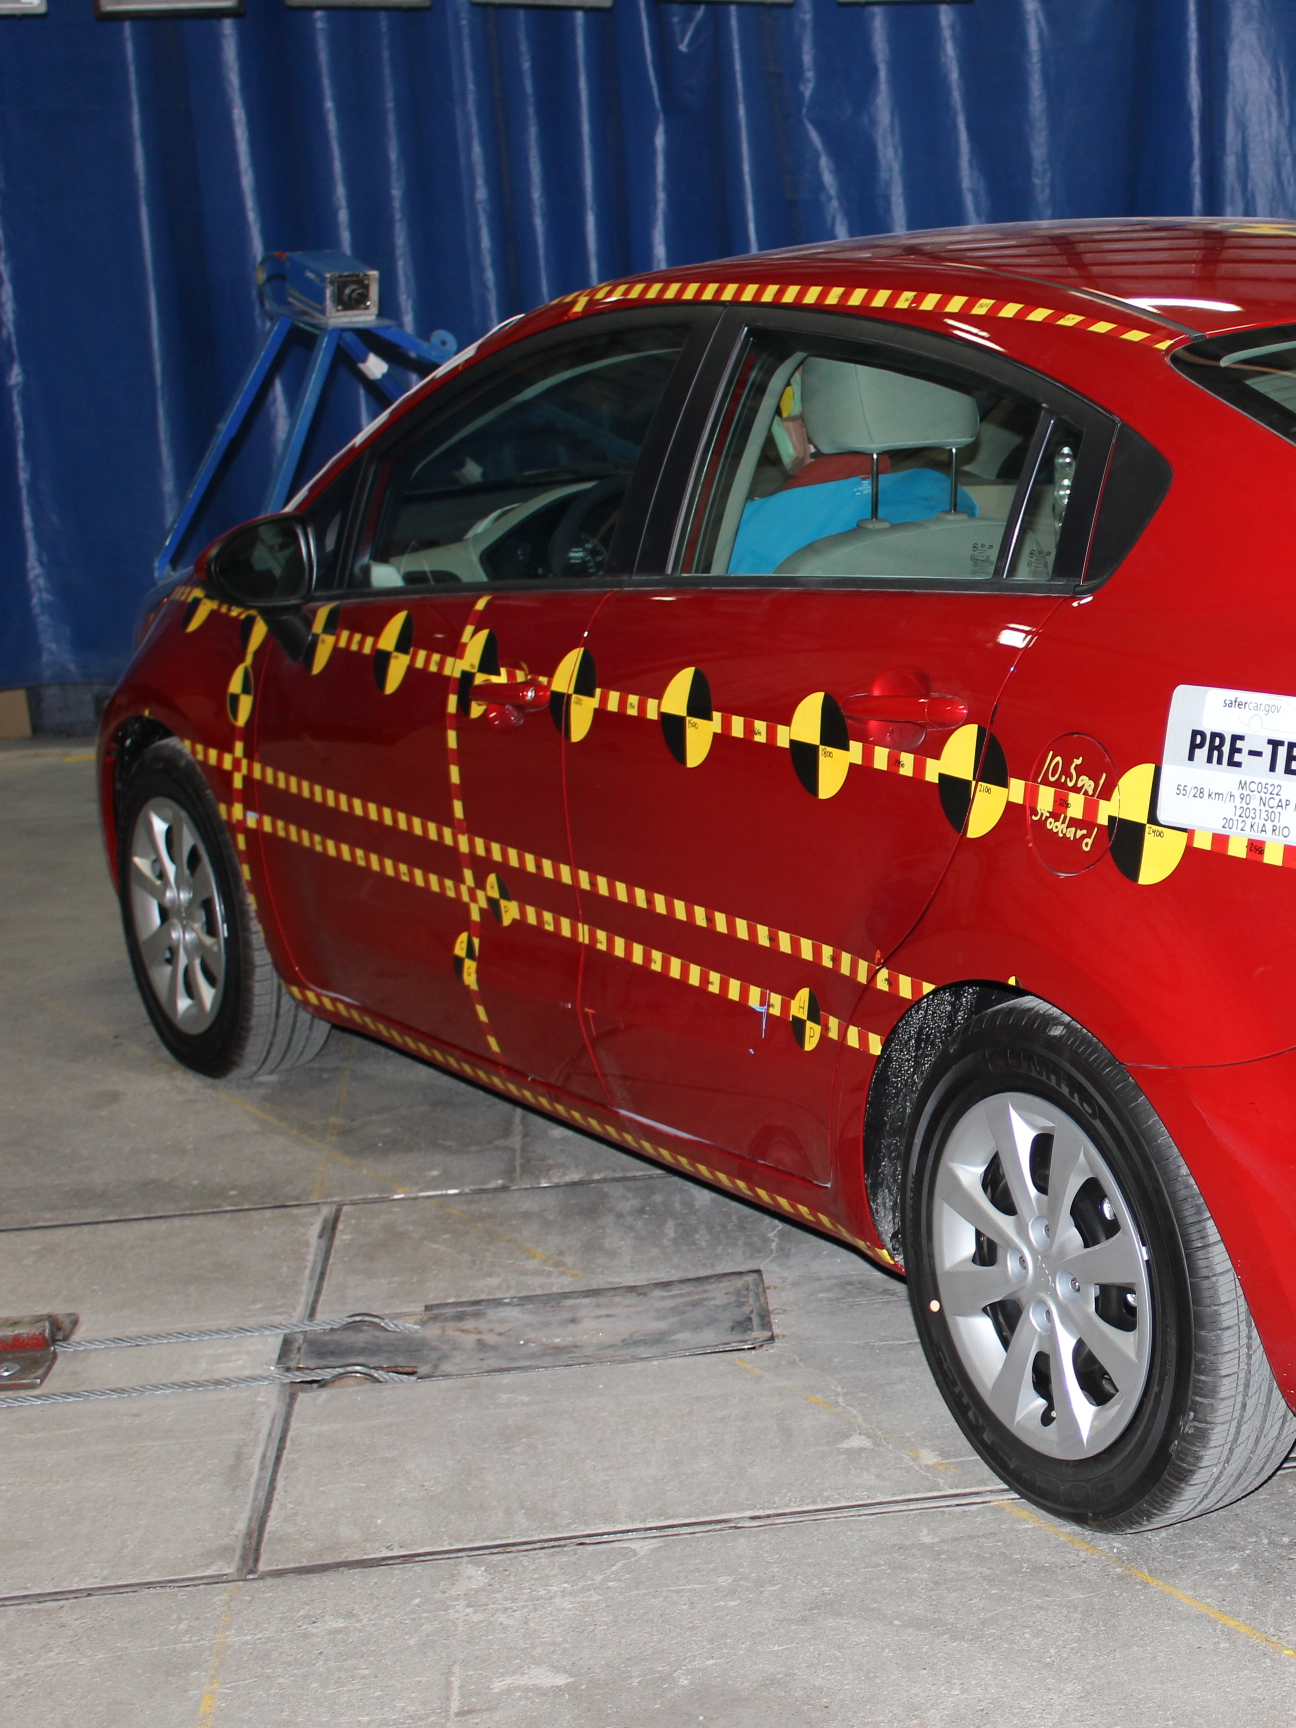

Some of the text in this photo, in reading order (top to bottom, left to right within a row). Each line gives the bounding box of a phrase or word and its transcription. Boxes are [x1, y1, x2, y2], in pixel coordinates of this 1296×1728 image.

[1222, 696, 1282, 715] safercar.gov
[978, 783, 992, 795] 2100
[1175, 783, 1205, 799] 55/28
[1207, 787, 1236, 804] km/h
[1258, 795, 1291, 811] NCAP
[1237, 779, 1283, 797] MC0522
[1233, 805, 1282, 823] 12031301
[1147, 826, 1165, 839] 2400
[1221, 817, 1291, 839] 2012 KIA RIO
